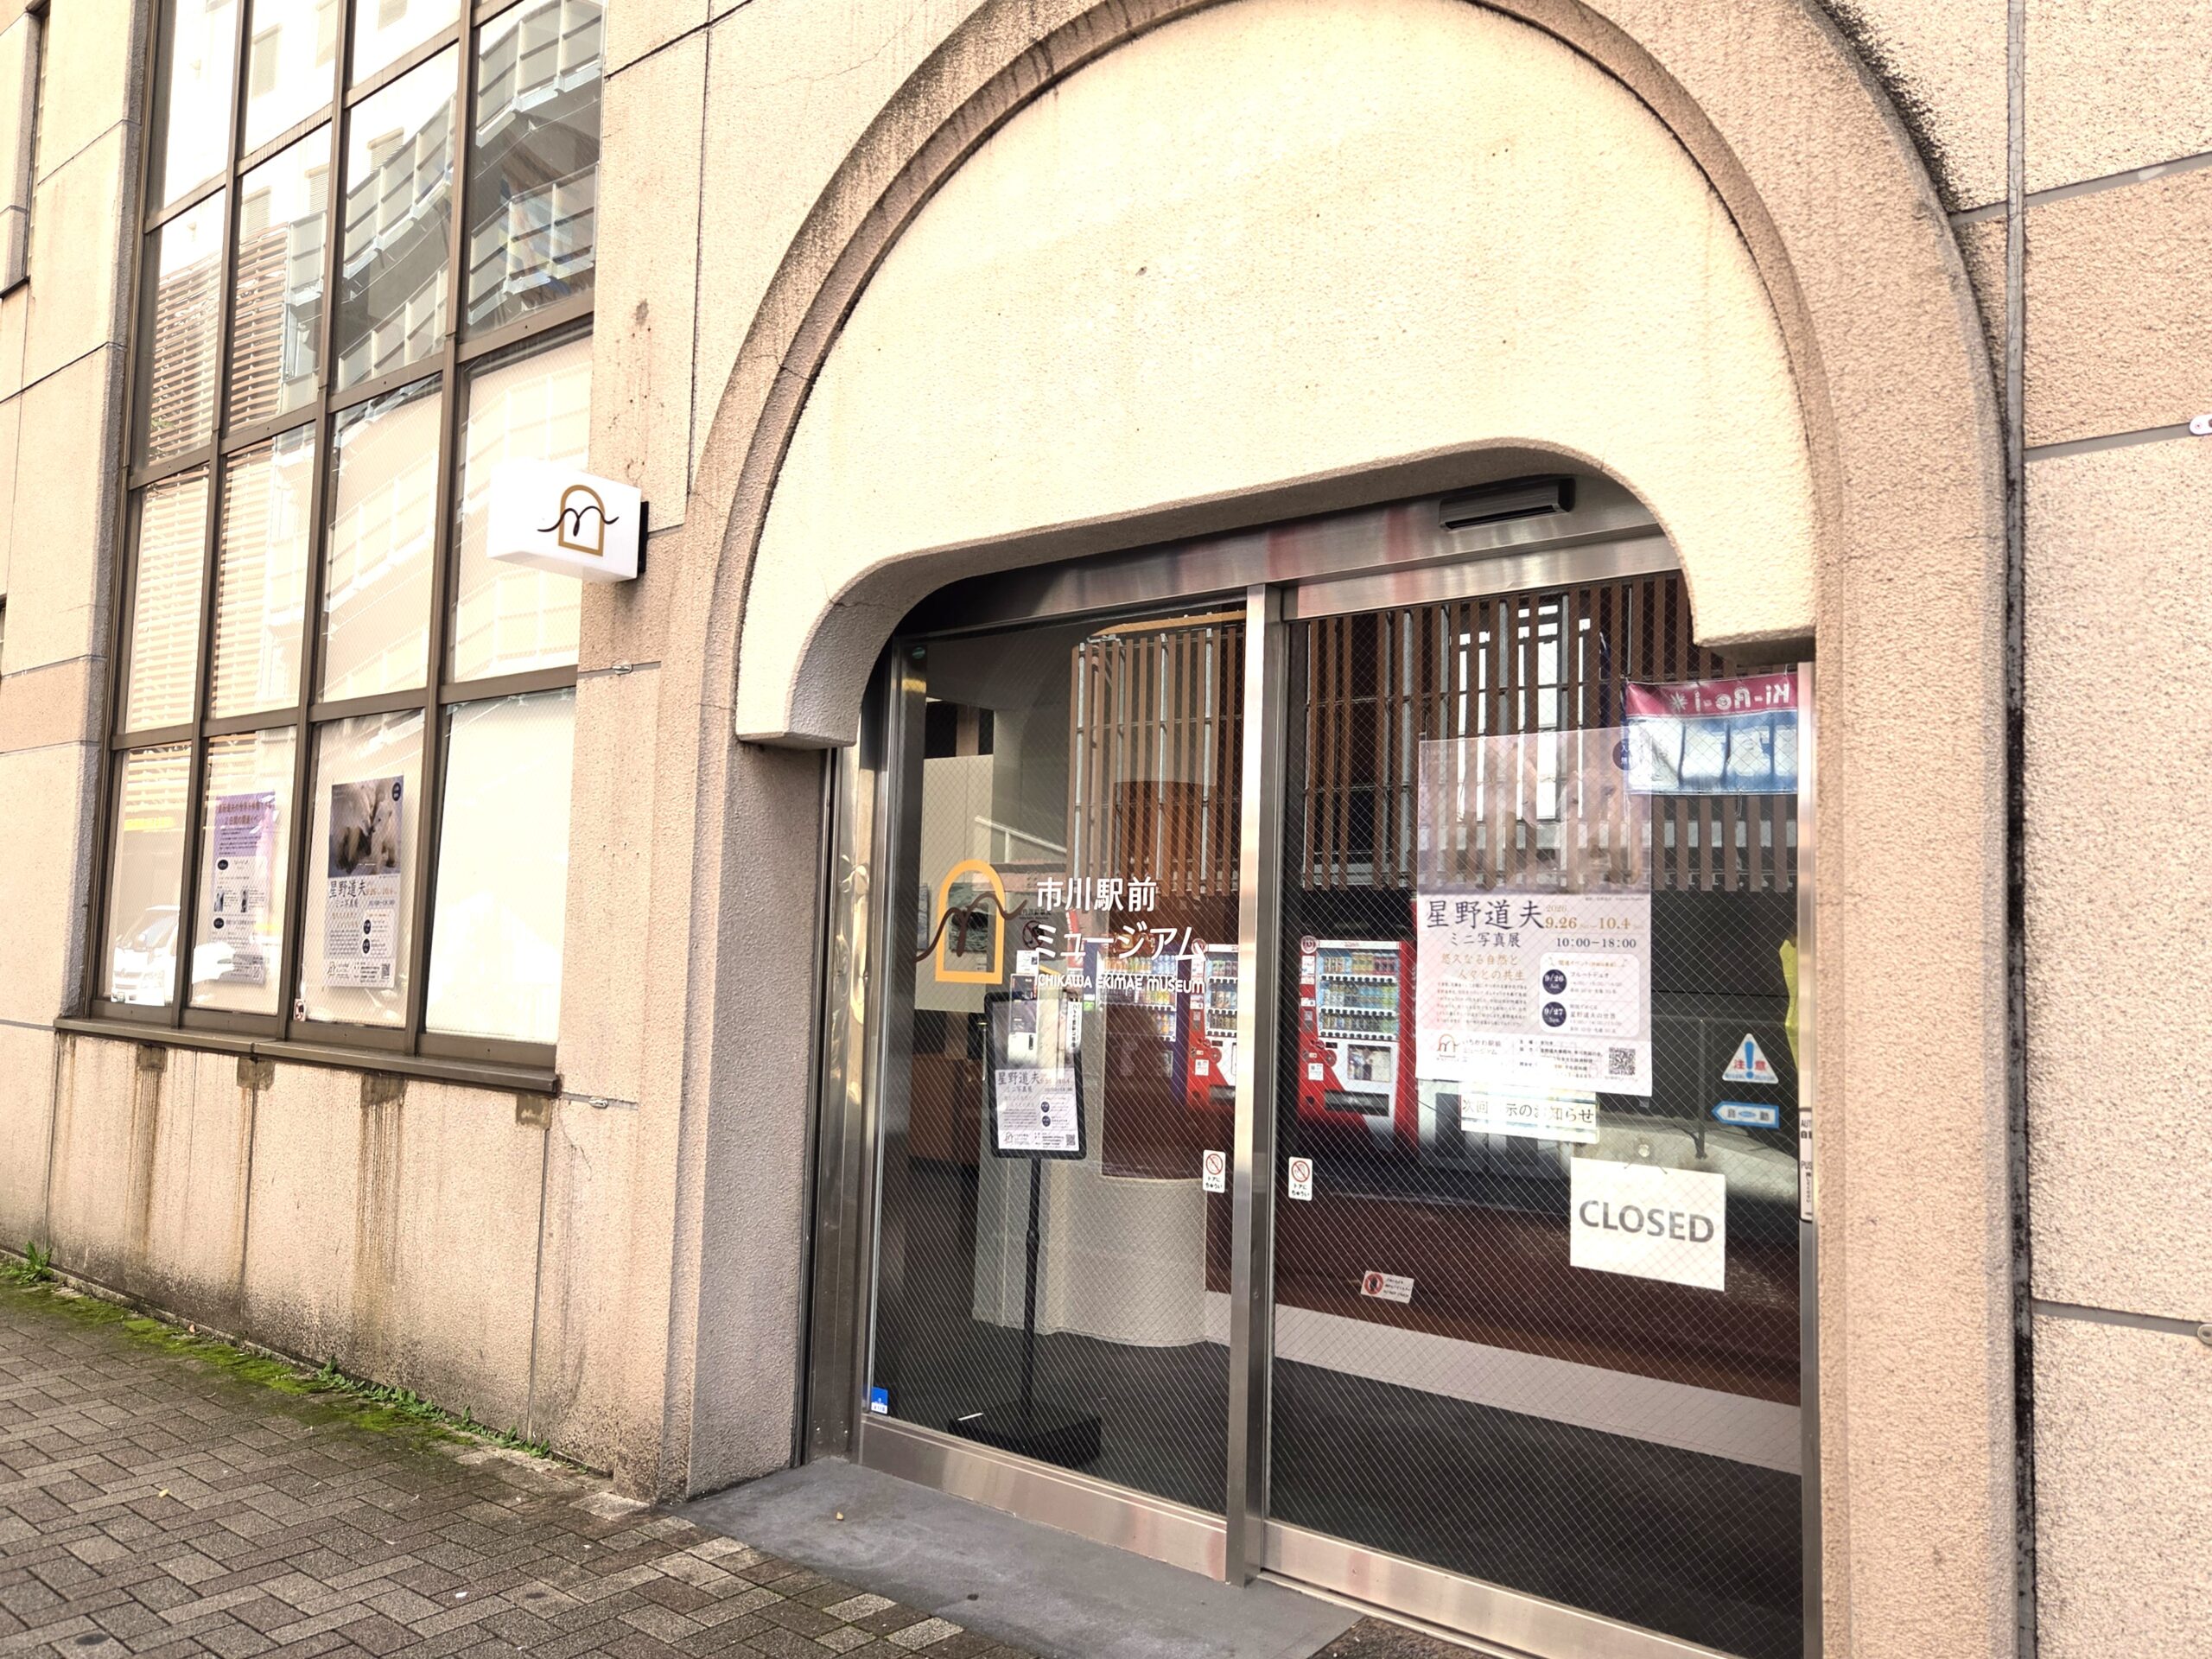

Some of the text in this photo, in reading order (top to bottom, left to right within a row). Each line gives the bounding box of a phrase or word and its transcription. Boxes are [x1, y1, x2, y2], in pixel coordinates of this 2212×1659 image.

[329, 880, 366, 899] 星野道夫
[1037, 877, 1157, 912] 市川駅前
[1427, 899, 1544, 930] 星野道夫
[1545, 917, 1630, 930] 9.26 10.4
[1036, 921, 1207, 963] ミュージアム
[1451, 932, 1521, 948] ミニ写真展
[1034, 974, 1092, 988] ICHIKAWA
[1459, 969, 1525, 982] 人々との共生
[1544, 973, 1565, 982] 9/26
[1543, 1007, 1564, 1016] 9/27
[1733, 1059, 1766, 1071] 注意
[998, 1071, 1040, 1086] 星野道夫
[1579, 1200, 1714, 1243] CLOSED
